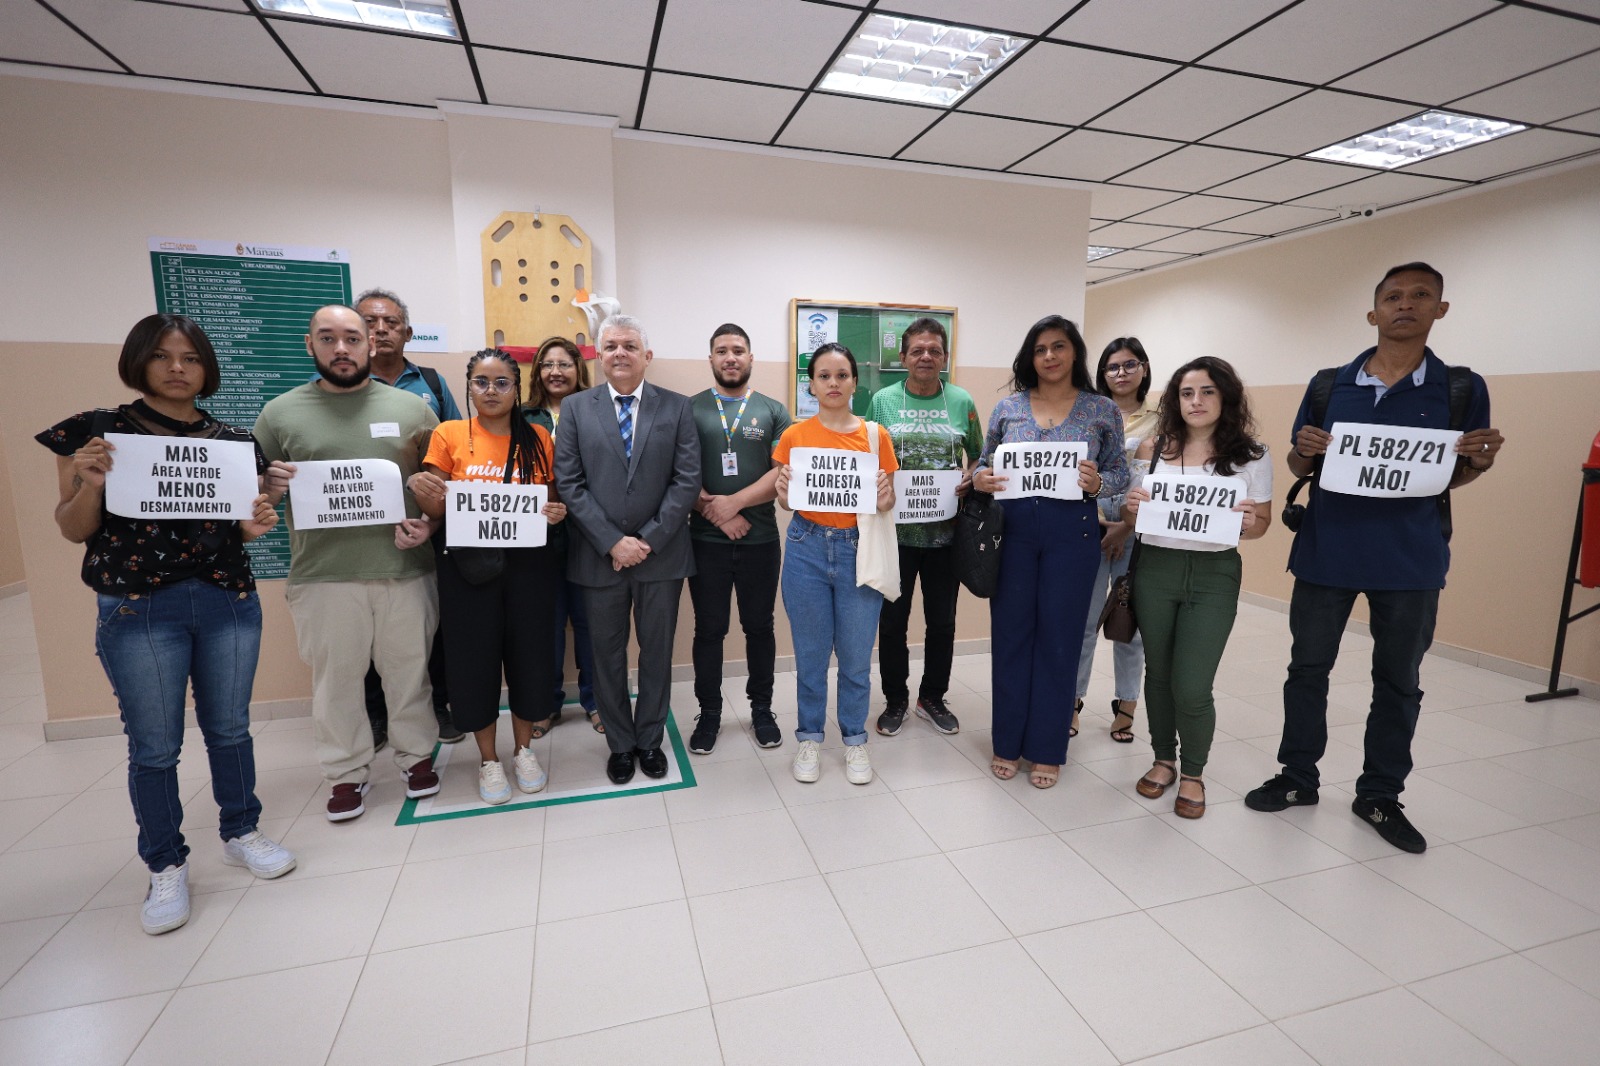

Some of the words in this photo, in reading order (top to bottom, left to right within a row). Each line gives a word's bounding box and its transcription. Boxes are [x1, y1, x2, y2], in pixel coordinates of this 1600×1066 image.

[245, 246, 284, 257] Manaus
[898, 409, 948, 419] TODOS
[165, 445, 208, 463] MAIS
[1339, 434, 1361, 457] PL
[1367, 436, 1447, 464] 582/21
[811, 455, 847, 470] SALVE
[850, 457, 858, 471] A
[1003, 451, 1020, 469] PL
[1023, 450, 1078, 469] 582/21
[151, 463, 182, 478] ÁREA
[185, 466, 221, 479] VERDE
[330, 465, 363, 480] MAIS
[1357, 463, 1411, 492] NÃO!
[323, 482, 346, 494] ÁREA
[347, 481, 375, 493] VERDE
[806, 472, 861, 490] FLORESTA
[911, 475, 934, 486] MAIS
[1022, 471, 1057, 492] NÃO!
[158, 481, 216, 498] MENOS
[905, 487, 921, 497] ÁREA
[921, 487, 940, 496] VERDE
[1151, 481, 1169, 502] PL
[1174, 483, 1237, 509] 582/21
[328, 495, 372, 510] MENOS
[456, 492, 476, 512] PL
[480, 493, 538, 514] 582/21
[808, 489, 858, 507] MANAÓS
[907, 498, 937, 509] MENOS
[140, 501, 232, 513] DESMATAMENTO
[899, 509, 945, 520] DESMATAMENTO
[317, 510, 385, 524] DESMATAMENTO
[1167, 507, 1210, 534] NÃO!
[478, 516, 517, 540] NÃO!
